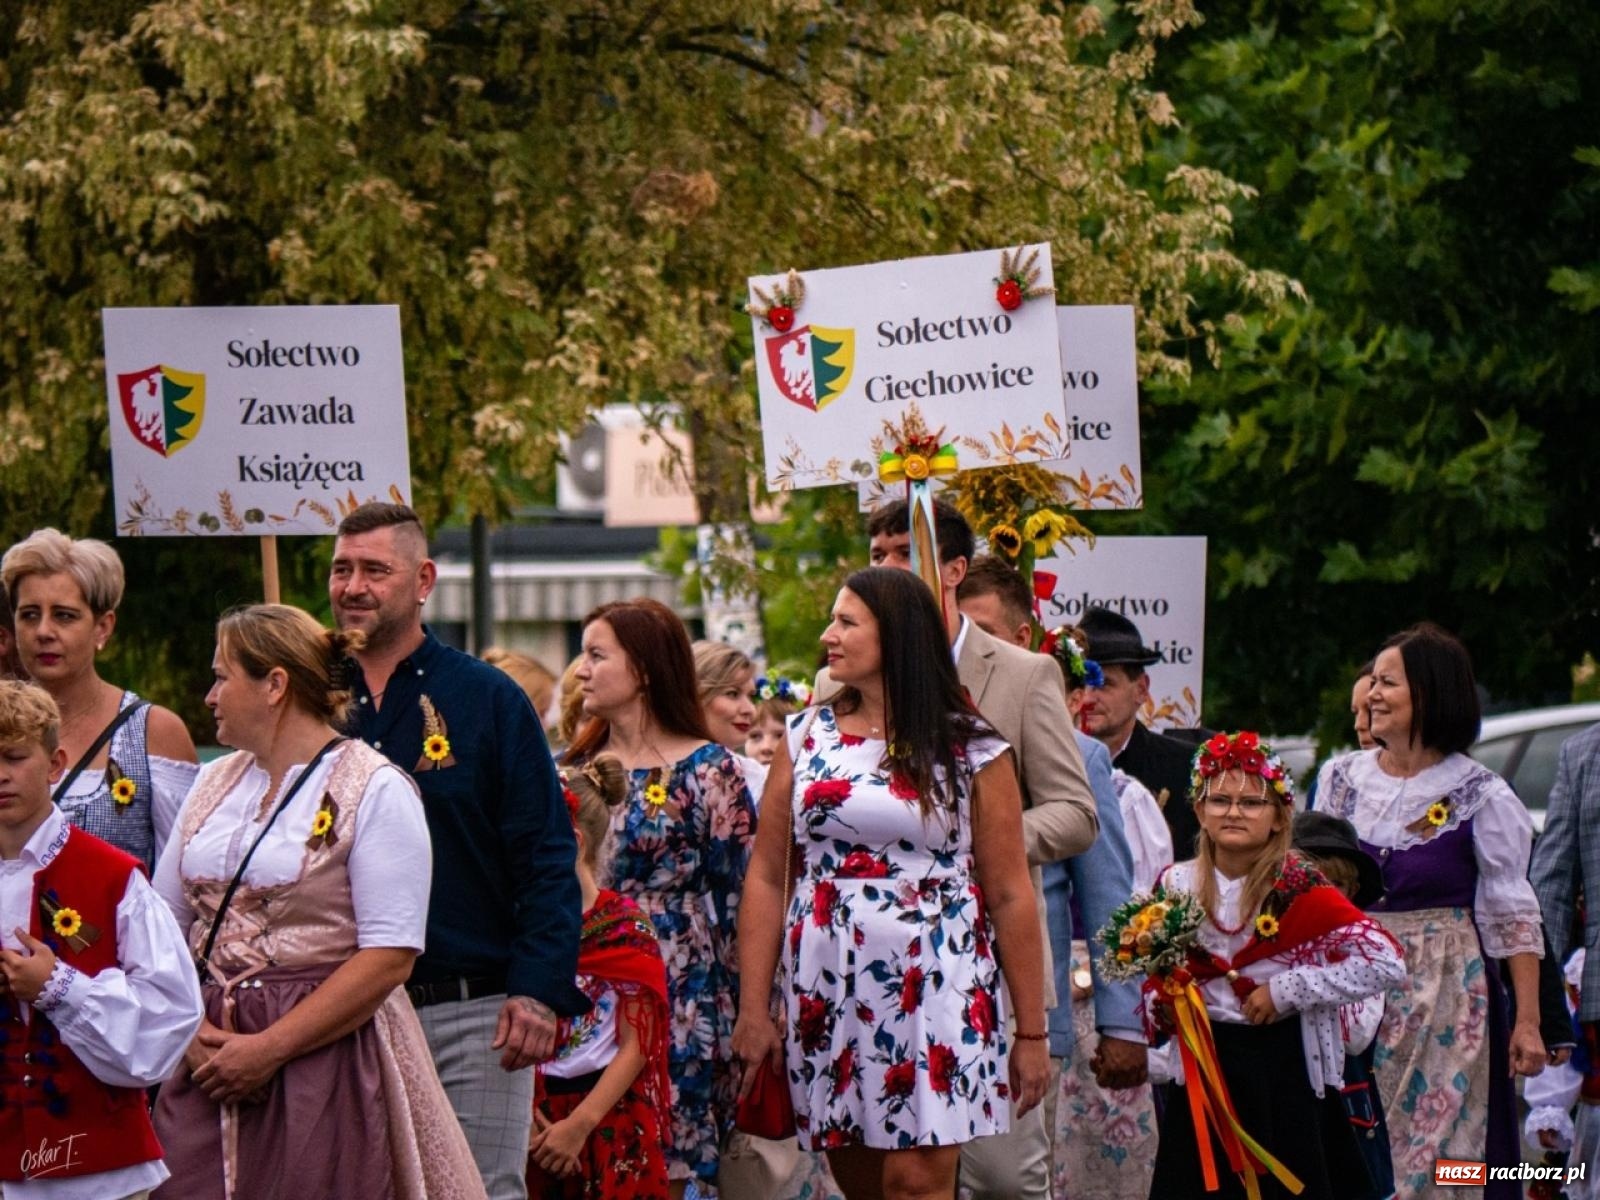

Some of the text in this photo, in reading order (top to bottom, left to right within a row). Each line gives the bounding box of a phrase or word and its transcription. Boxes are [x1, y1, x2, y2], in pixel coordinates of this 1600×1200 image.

[876, 313, 1013, 348] Sołectwo
[226, 339, 361, 368] Sołectwo
[864, 361, 1034, 403] Ciechowice
[239, 396, 355, 425] Zawada
[237, 452, 364, 489] Książęca
